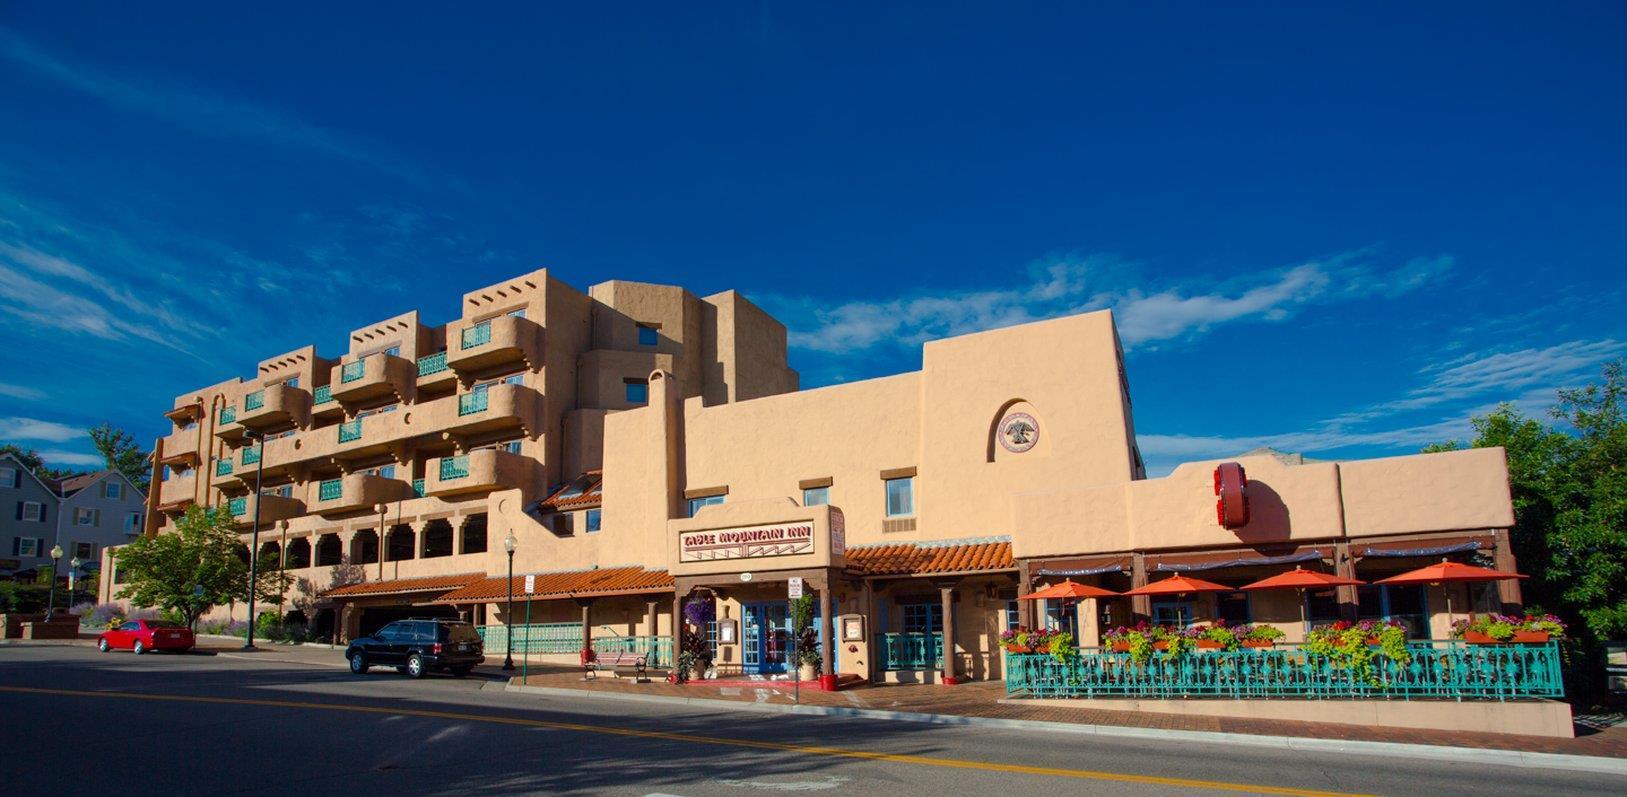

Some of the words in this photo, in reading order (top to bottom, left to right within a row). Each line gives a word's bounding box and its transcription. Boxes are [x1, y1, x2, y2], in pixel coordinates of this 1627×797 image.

[684, 534, 716, 546] TABLE
[719, 528, 784, 543] MOUNTAIN
[787, 526, 811, 538] INN
